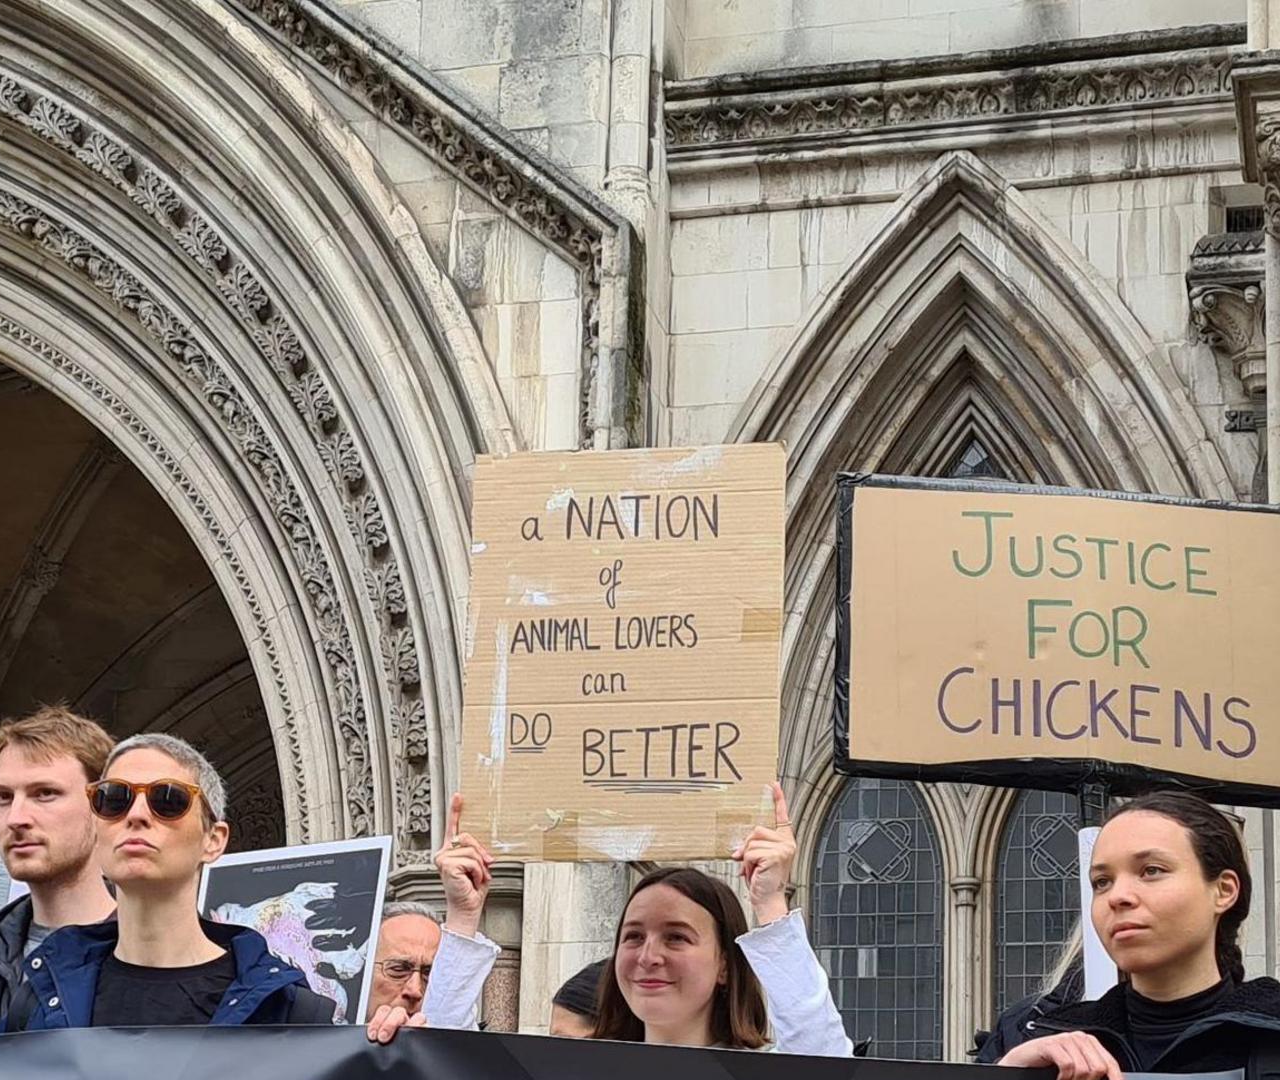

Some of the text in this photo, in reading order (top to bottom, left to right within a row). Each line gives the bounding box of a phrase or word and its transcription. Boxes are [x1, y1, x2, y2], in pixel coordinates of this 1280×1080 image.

[521, 494, 719, 541] a NATION
[952, 510, 1218, 597] JUSTICE
[599, 559, 622, 608] of
[510, 614, 698, 654] ANIMAL LOVERS
[1028, 599, 1150, 669] FOR
[582, 671, 626, 696] can
[937, 666, 1257, 759] CHICKENS
[510, 712, 743, 781] DO BETTER
